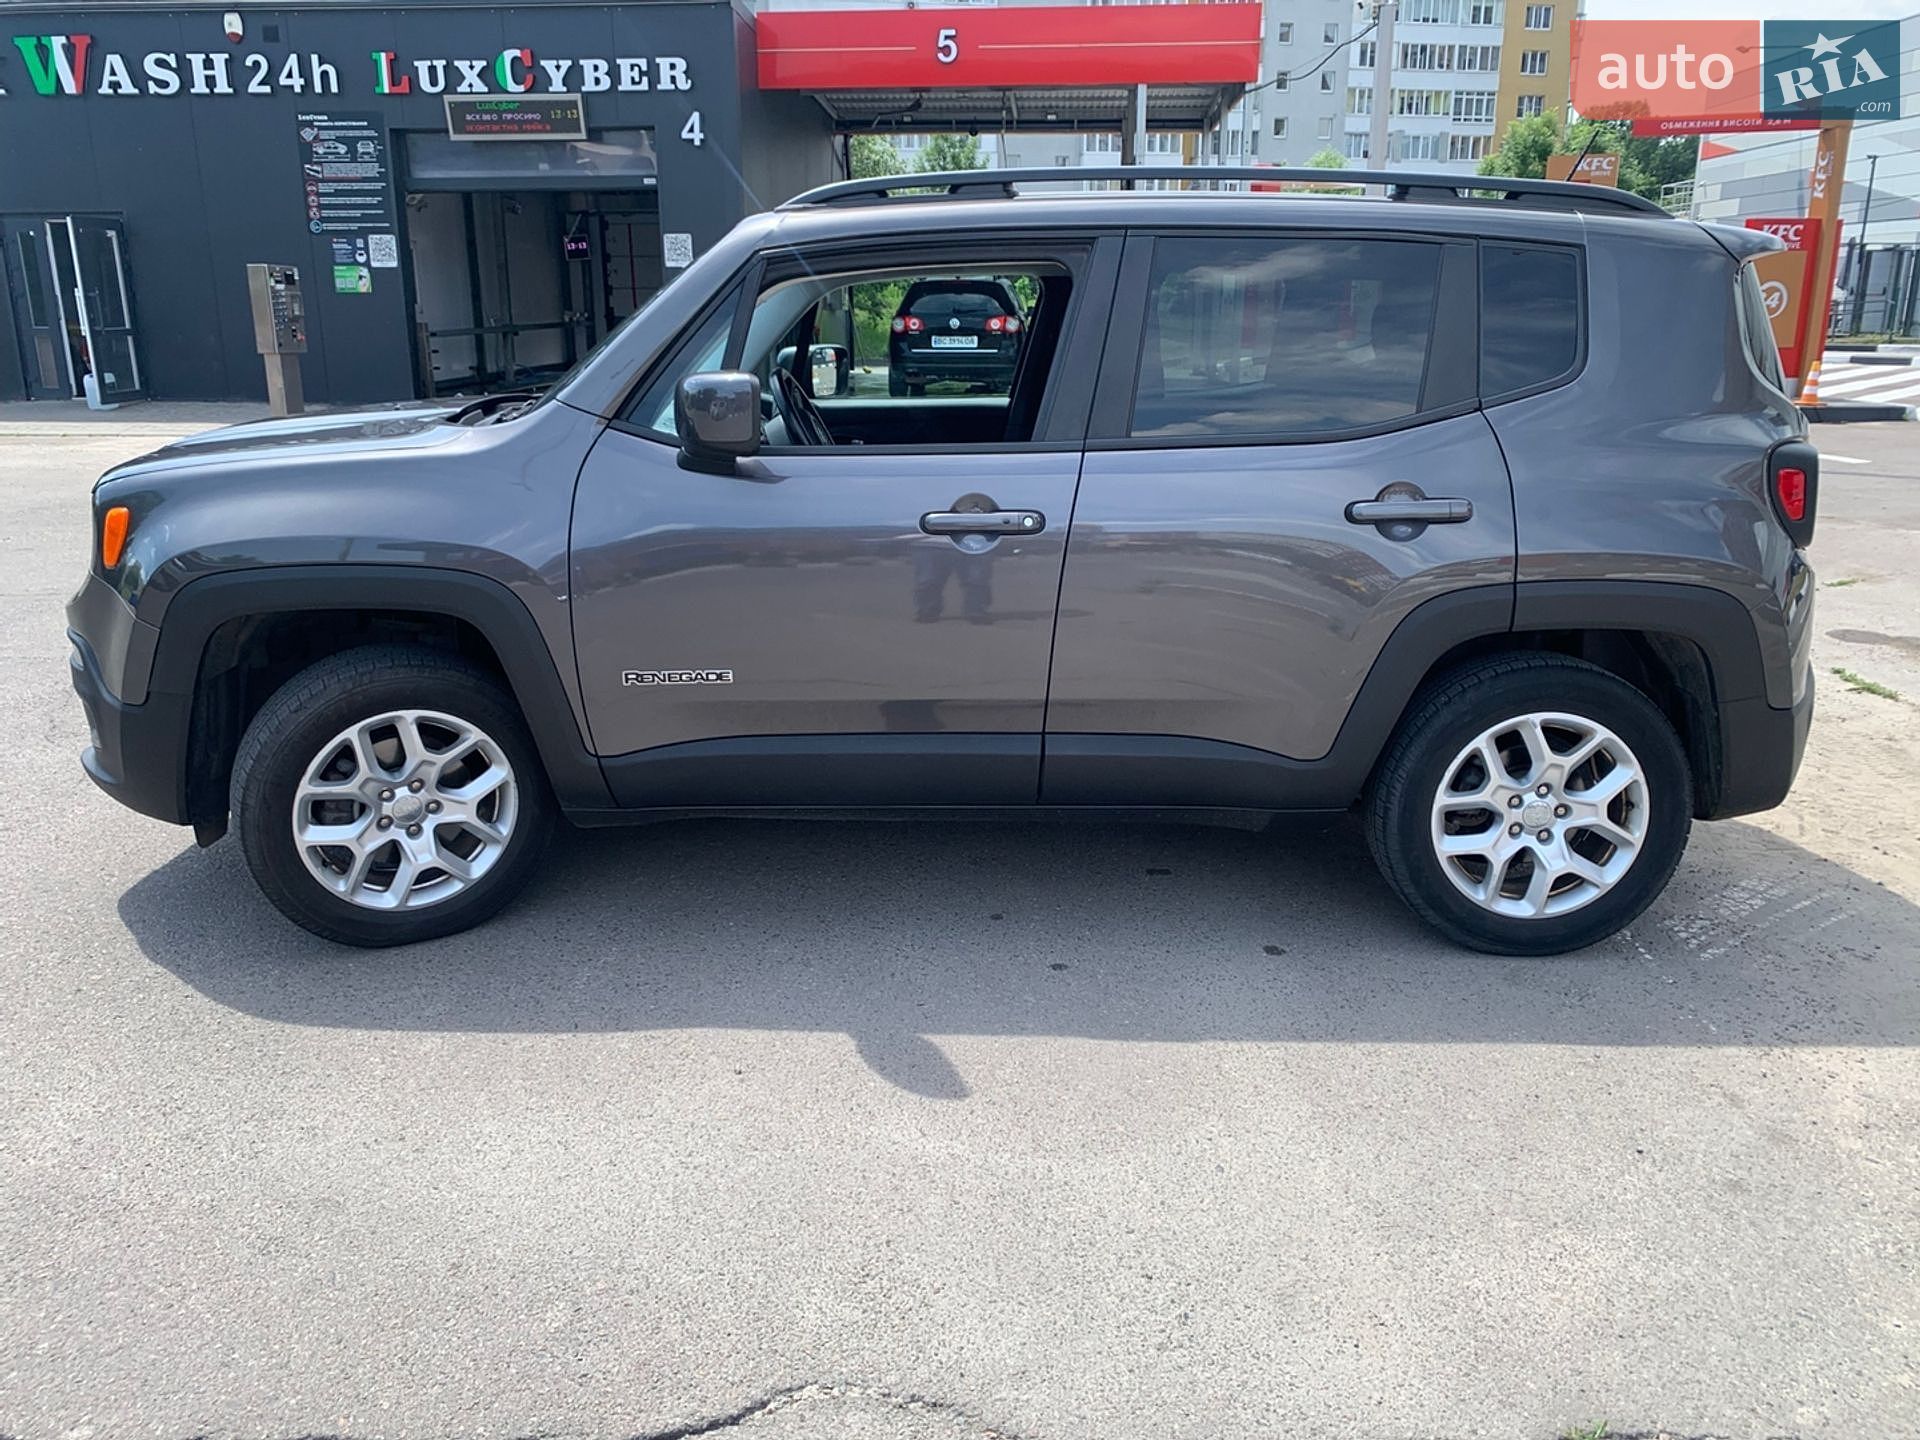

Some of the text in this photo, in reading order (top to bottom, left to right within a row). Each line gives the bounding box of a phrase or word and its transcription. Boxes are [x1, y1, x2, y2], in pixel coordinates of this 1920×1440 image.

[937, 28, 958, 64] 5
[13, 35, 339, 95] WASH 24h
[680, 111, 705, 147] 4
[1577, 157, 1616, 170] KFC
[1814, 152, 1830, 199] KFC
[622, 669, 733, 686] RENEGADE
